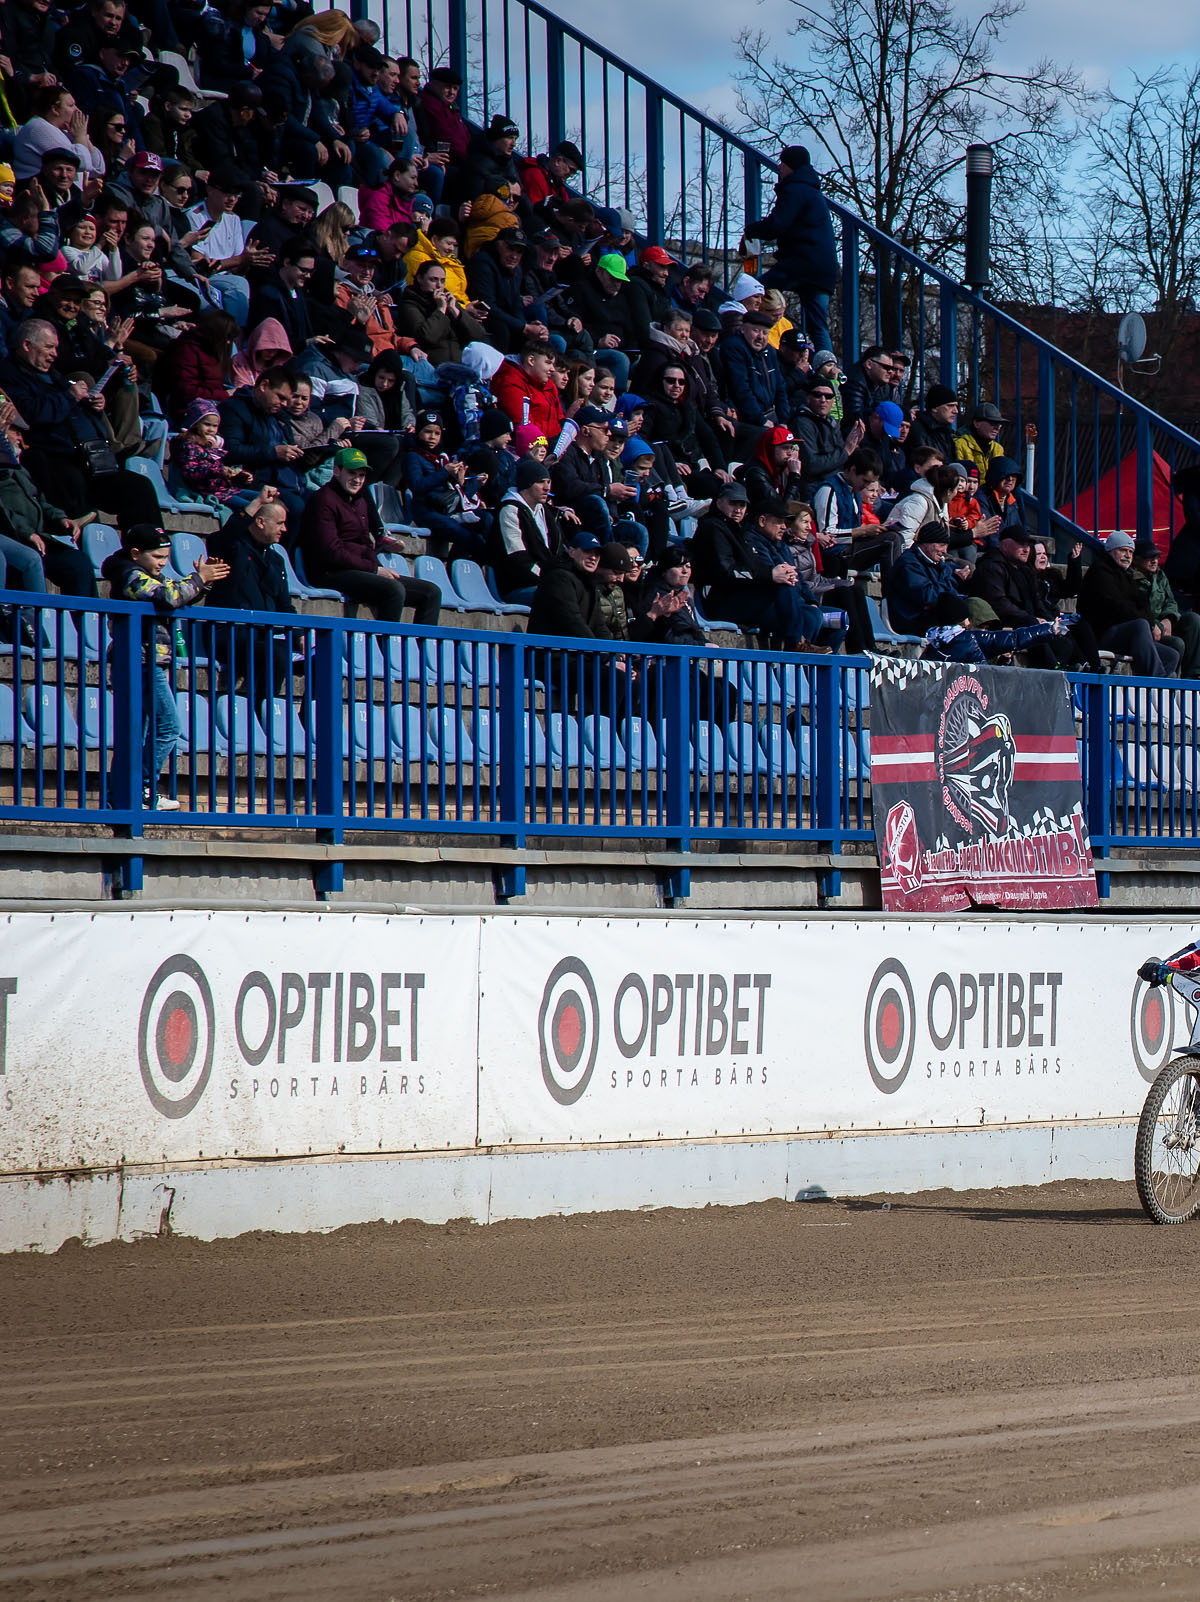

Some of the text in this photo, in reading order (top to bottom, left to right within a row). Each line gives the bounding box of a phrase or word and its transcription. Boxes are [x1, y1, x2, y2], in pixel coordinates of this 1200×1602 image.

[235, 971, 425, 1066] OPTIBET
[613, 973, 772, 1059] OPTIBET
[927, 971, 1063, 1052] OPTIBET
[230, 1077, 338, 1100] SPORTA
[610, 1062, 768, 1089] SPORTA BĀRS
[926, 1053, 1061, 1079] SPORTA BĀRS
